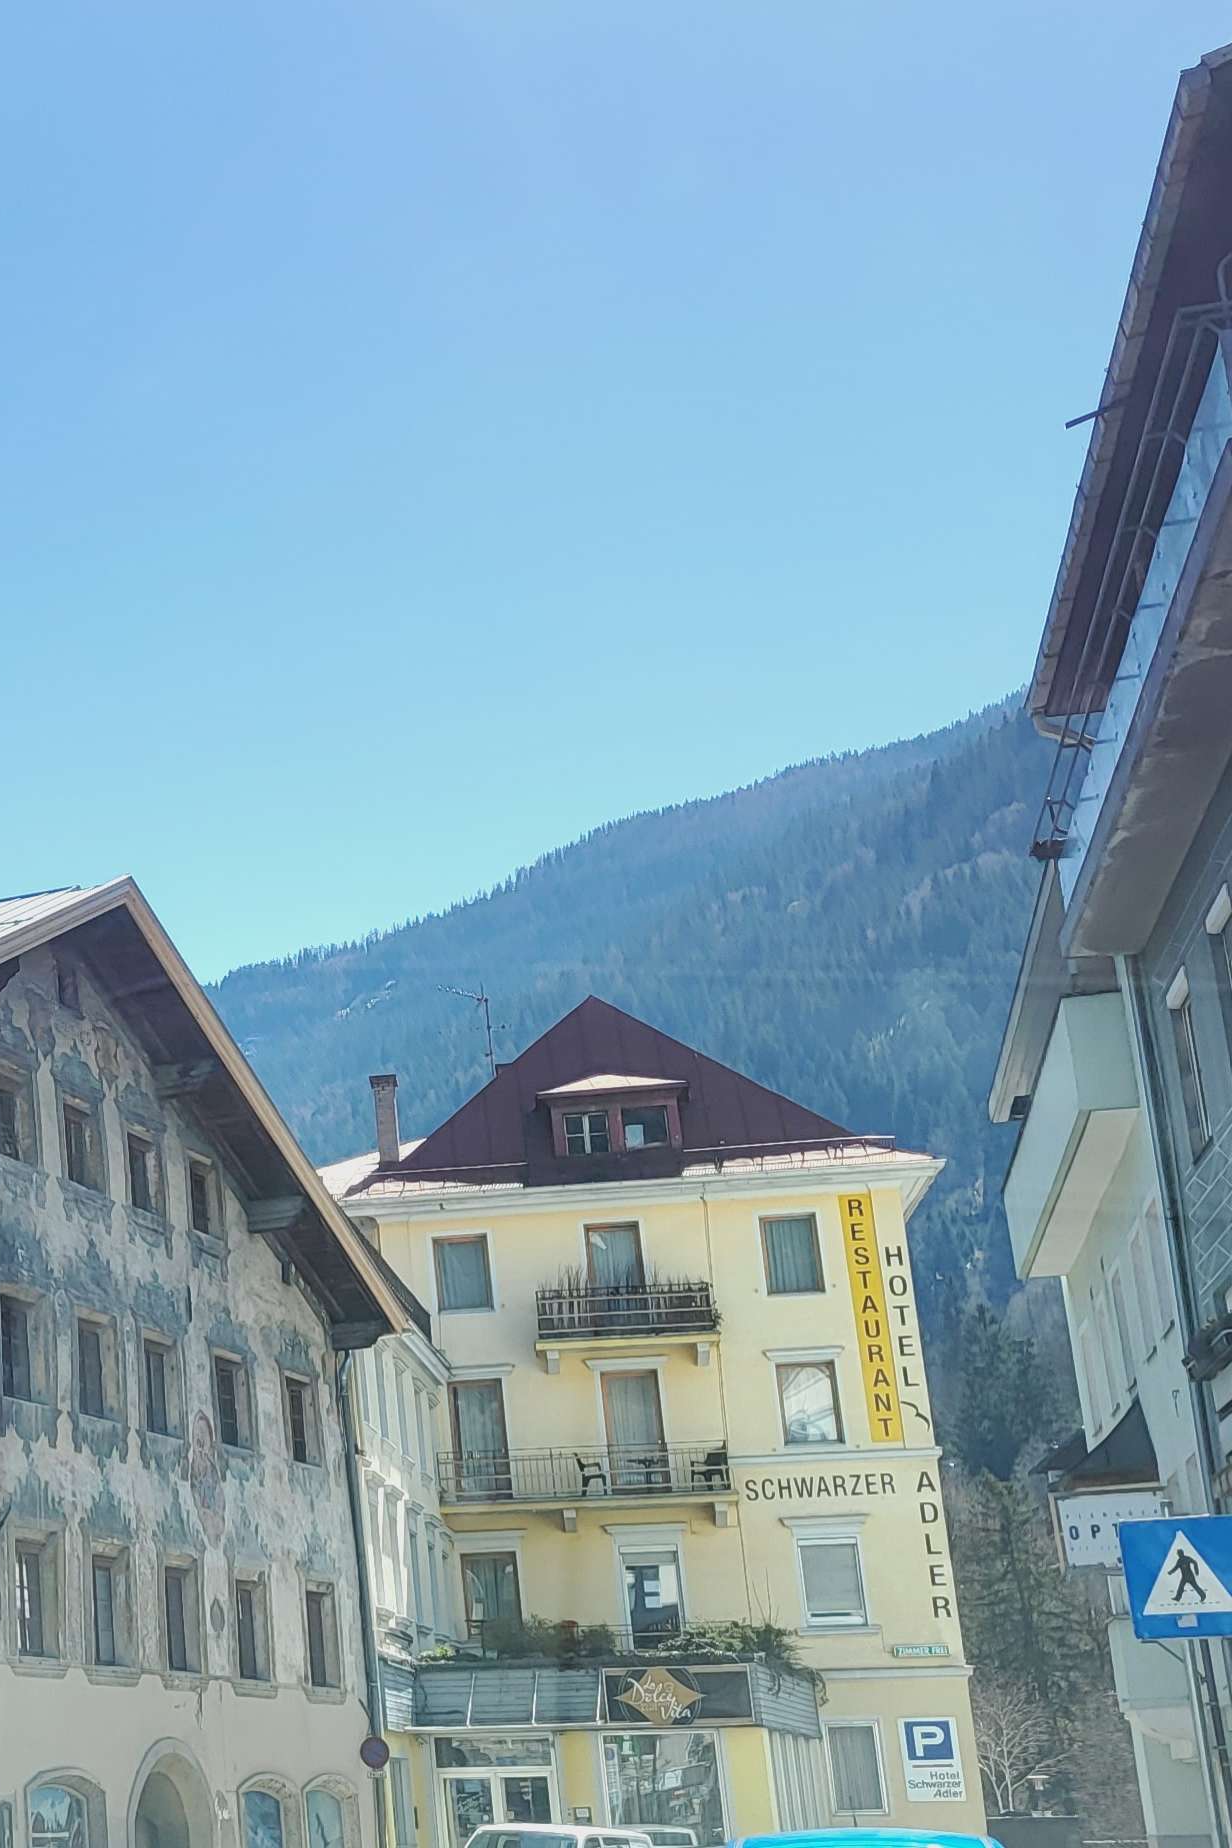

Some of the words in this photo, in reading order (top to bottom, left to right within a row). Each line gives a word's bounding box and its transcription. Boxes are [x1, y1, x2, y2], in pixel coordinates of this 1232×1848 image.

[847, 1198, 893, 1437] RESTAURANT
[884, 1245, 920, 1387] HOTEL
[744, 1472, 896, 1501] SCHWARZER
[916, 1471, 952, 1619] ADLER
[627, 1678, 674, 1704] Dolce
[660, 1696, 692, 1720] Vita
[912, 1725, 945, 1757] P
[907, 1779, 962, 1790] Schwarzer
[929, 1771, 960, 1781] Hotel
[933, 1789, 964, 1799] Adler
